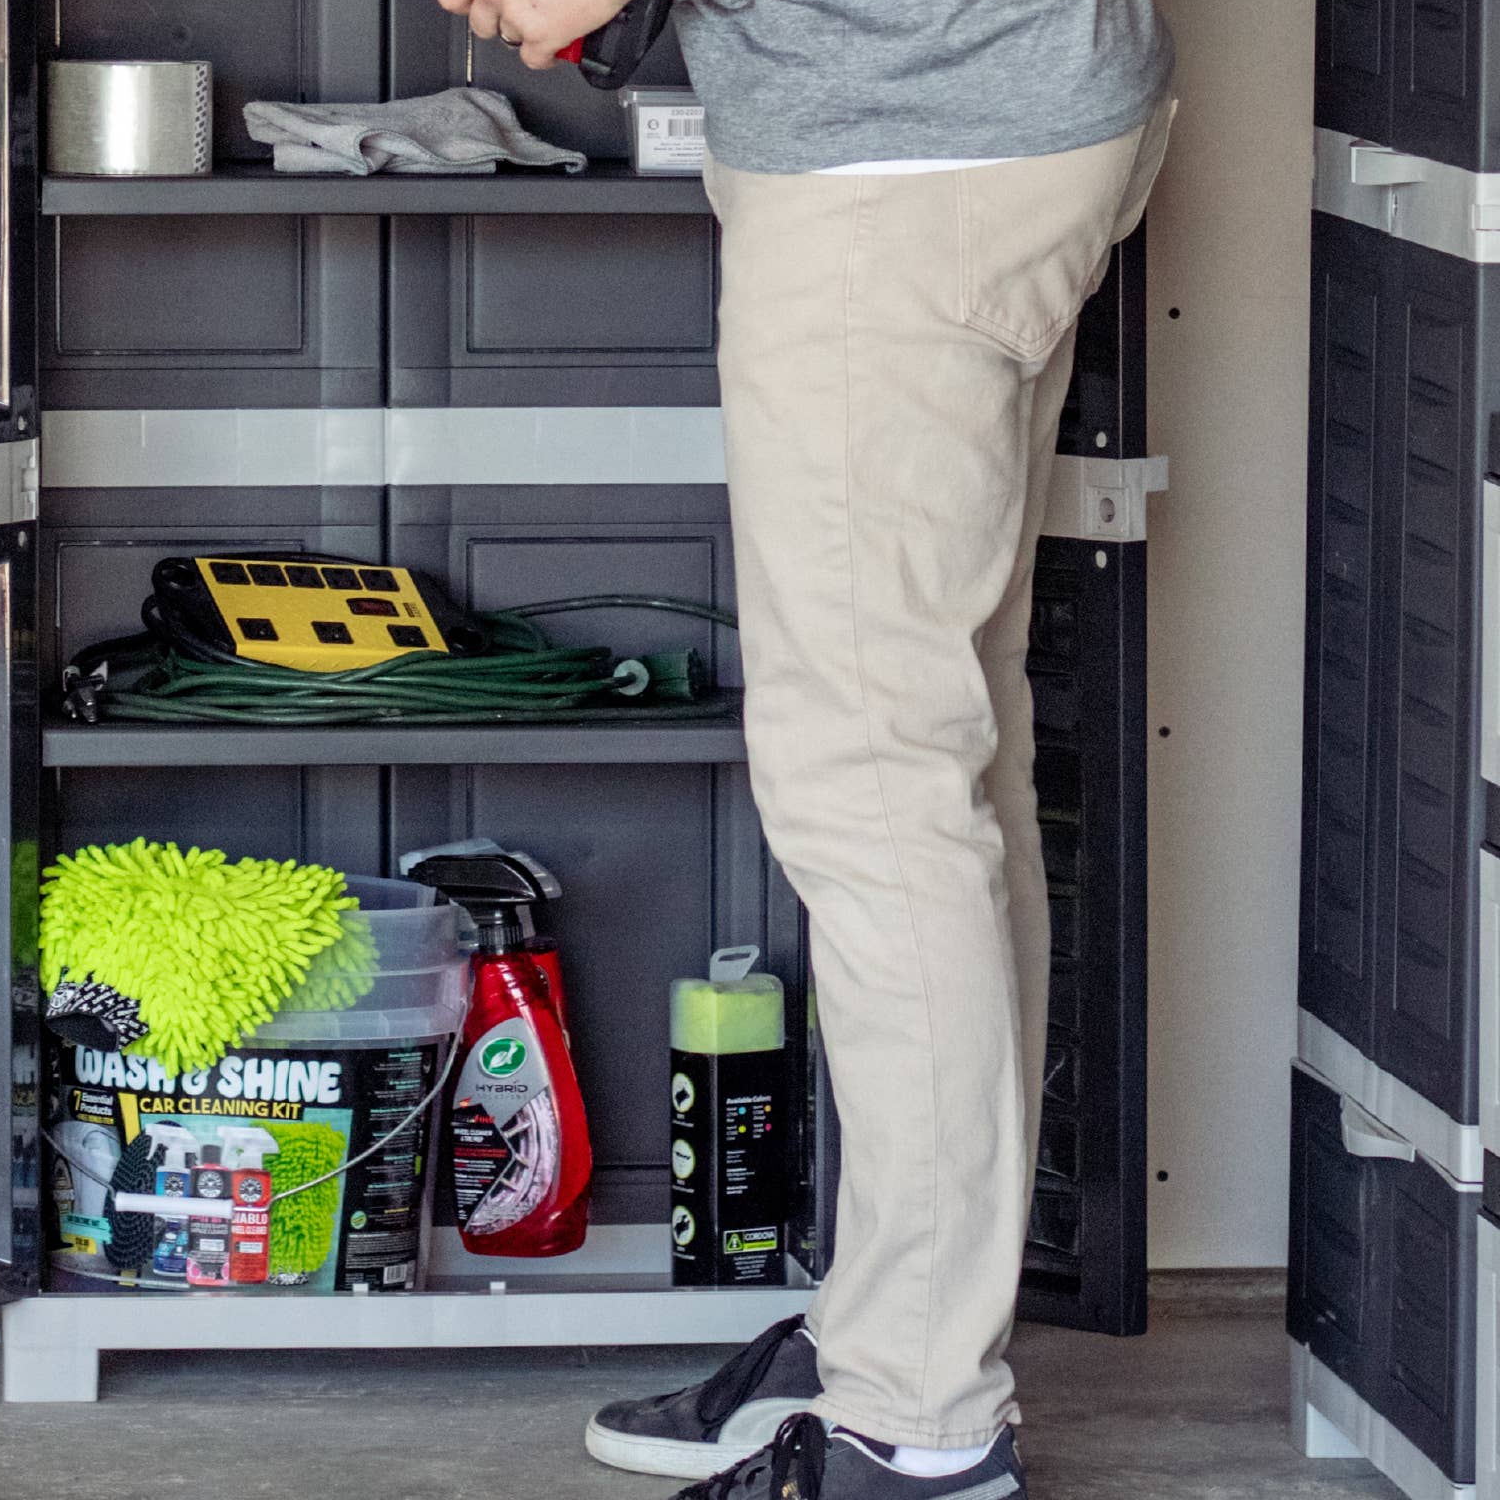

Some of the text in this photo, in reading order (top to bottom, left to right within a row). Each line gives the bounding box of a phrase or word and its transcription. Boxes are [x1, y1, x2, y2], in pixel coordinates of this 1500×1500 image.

[75, 1046, 176, 1094] WASH
[216, 1056, 342, 1104] SHINE
[475, 1081, 528, 1093] HYBRID
[73, 1090, 81, 1111] 7
[139, 1097, 302, 1120] CAR CLEANING KIT
